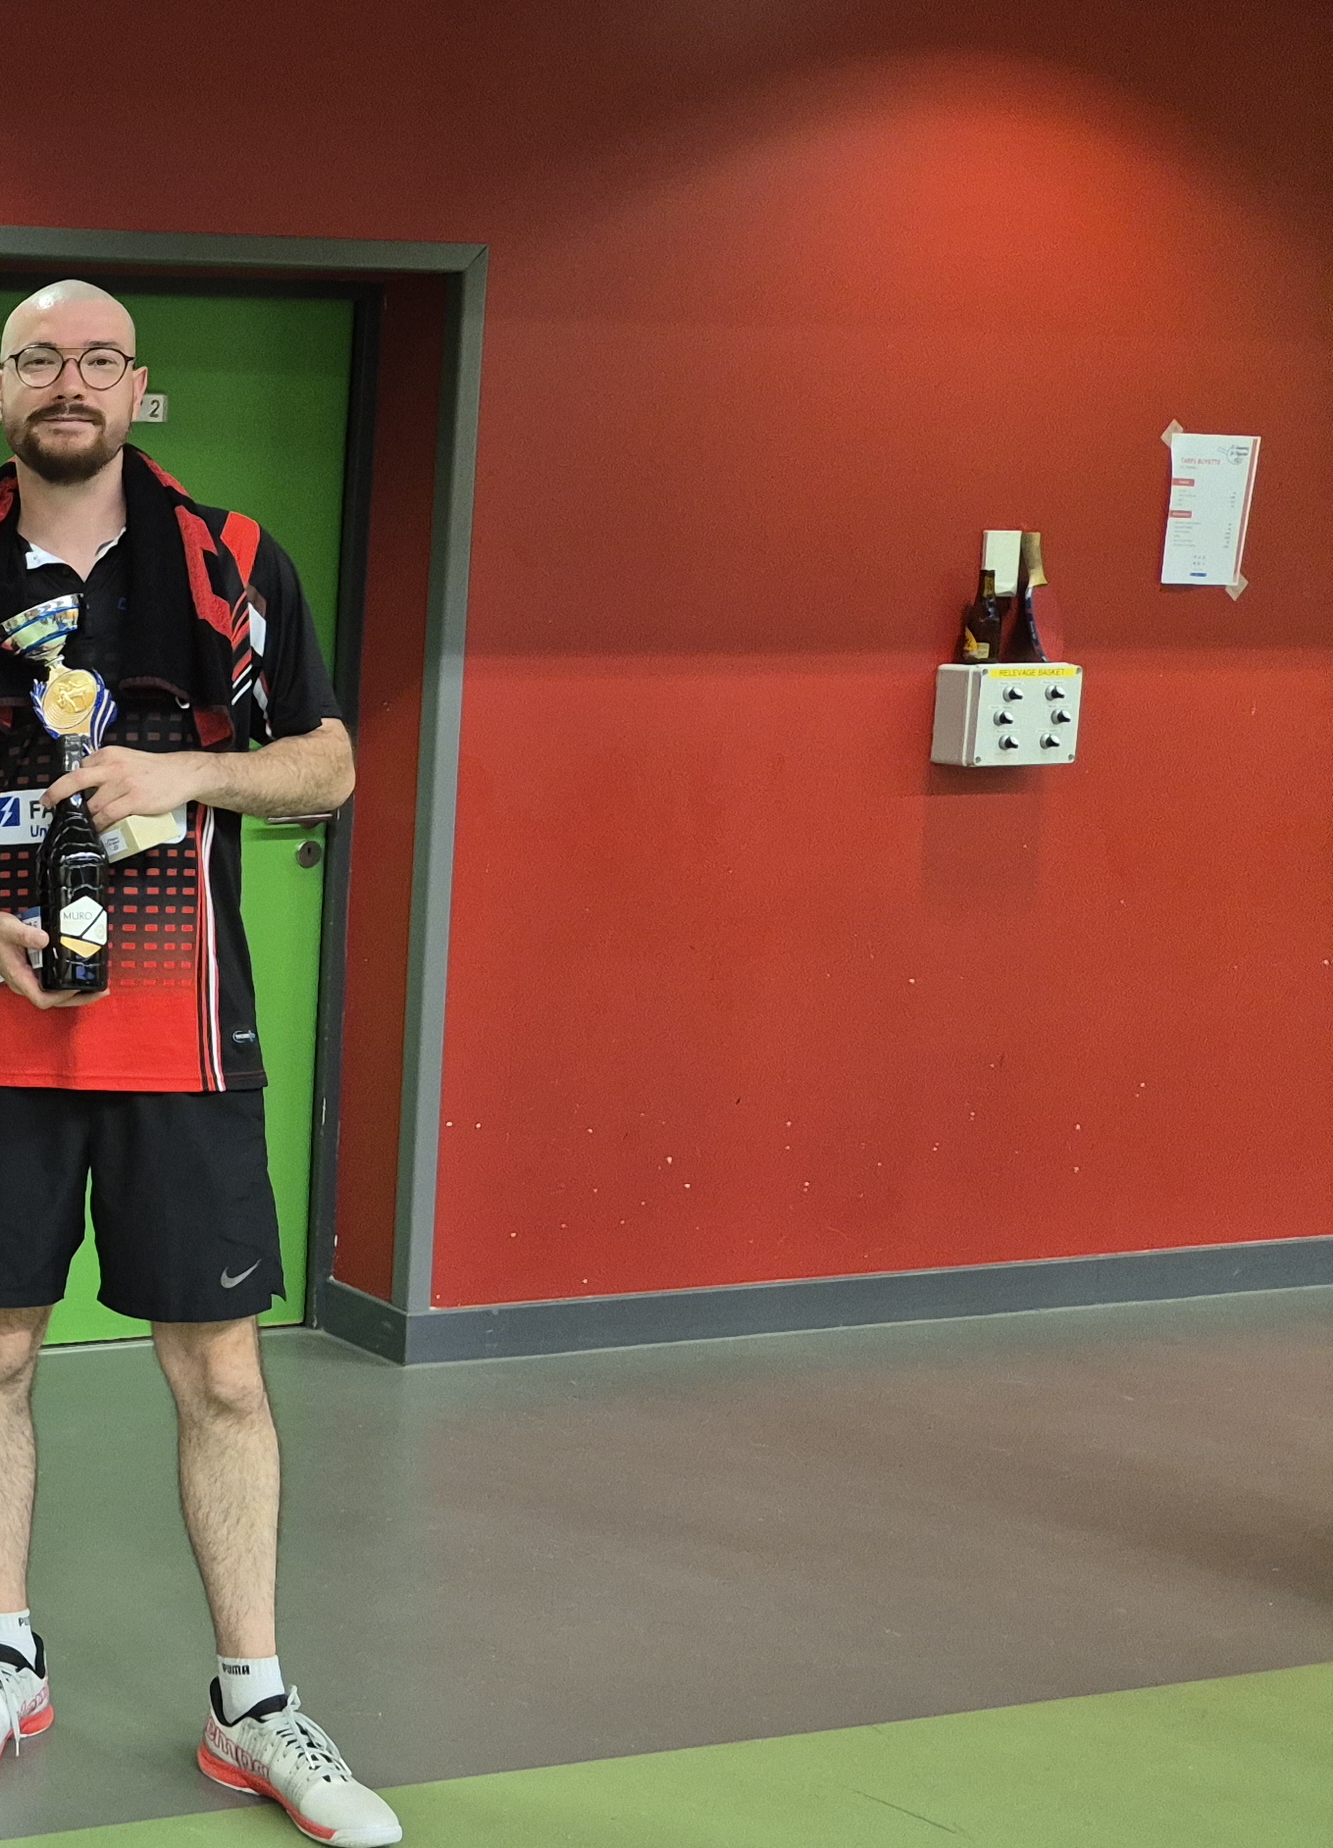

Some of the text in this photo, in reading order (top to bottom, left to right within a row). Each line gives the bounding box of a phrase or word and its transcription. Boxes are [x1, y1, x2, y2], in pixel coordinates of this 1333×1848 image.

[999, 668, 1065, 677] RELEVAGE BASKET
[63, 911, 93, 920] MURO
[221, 1662, 250, 1675] PUMA
